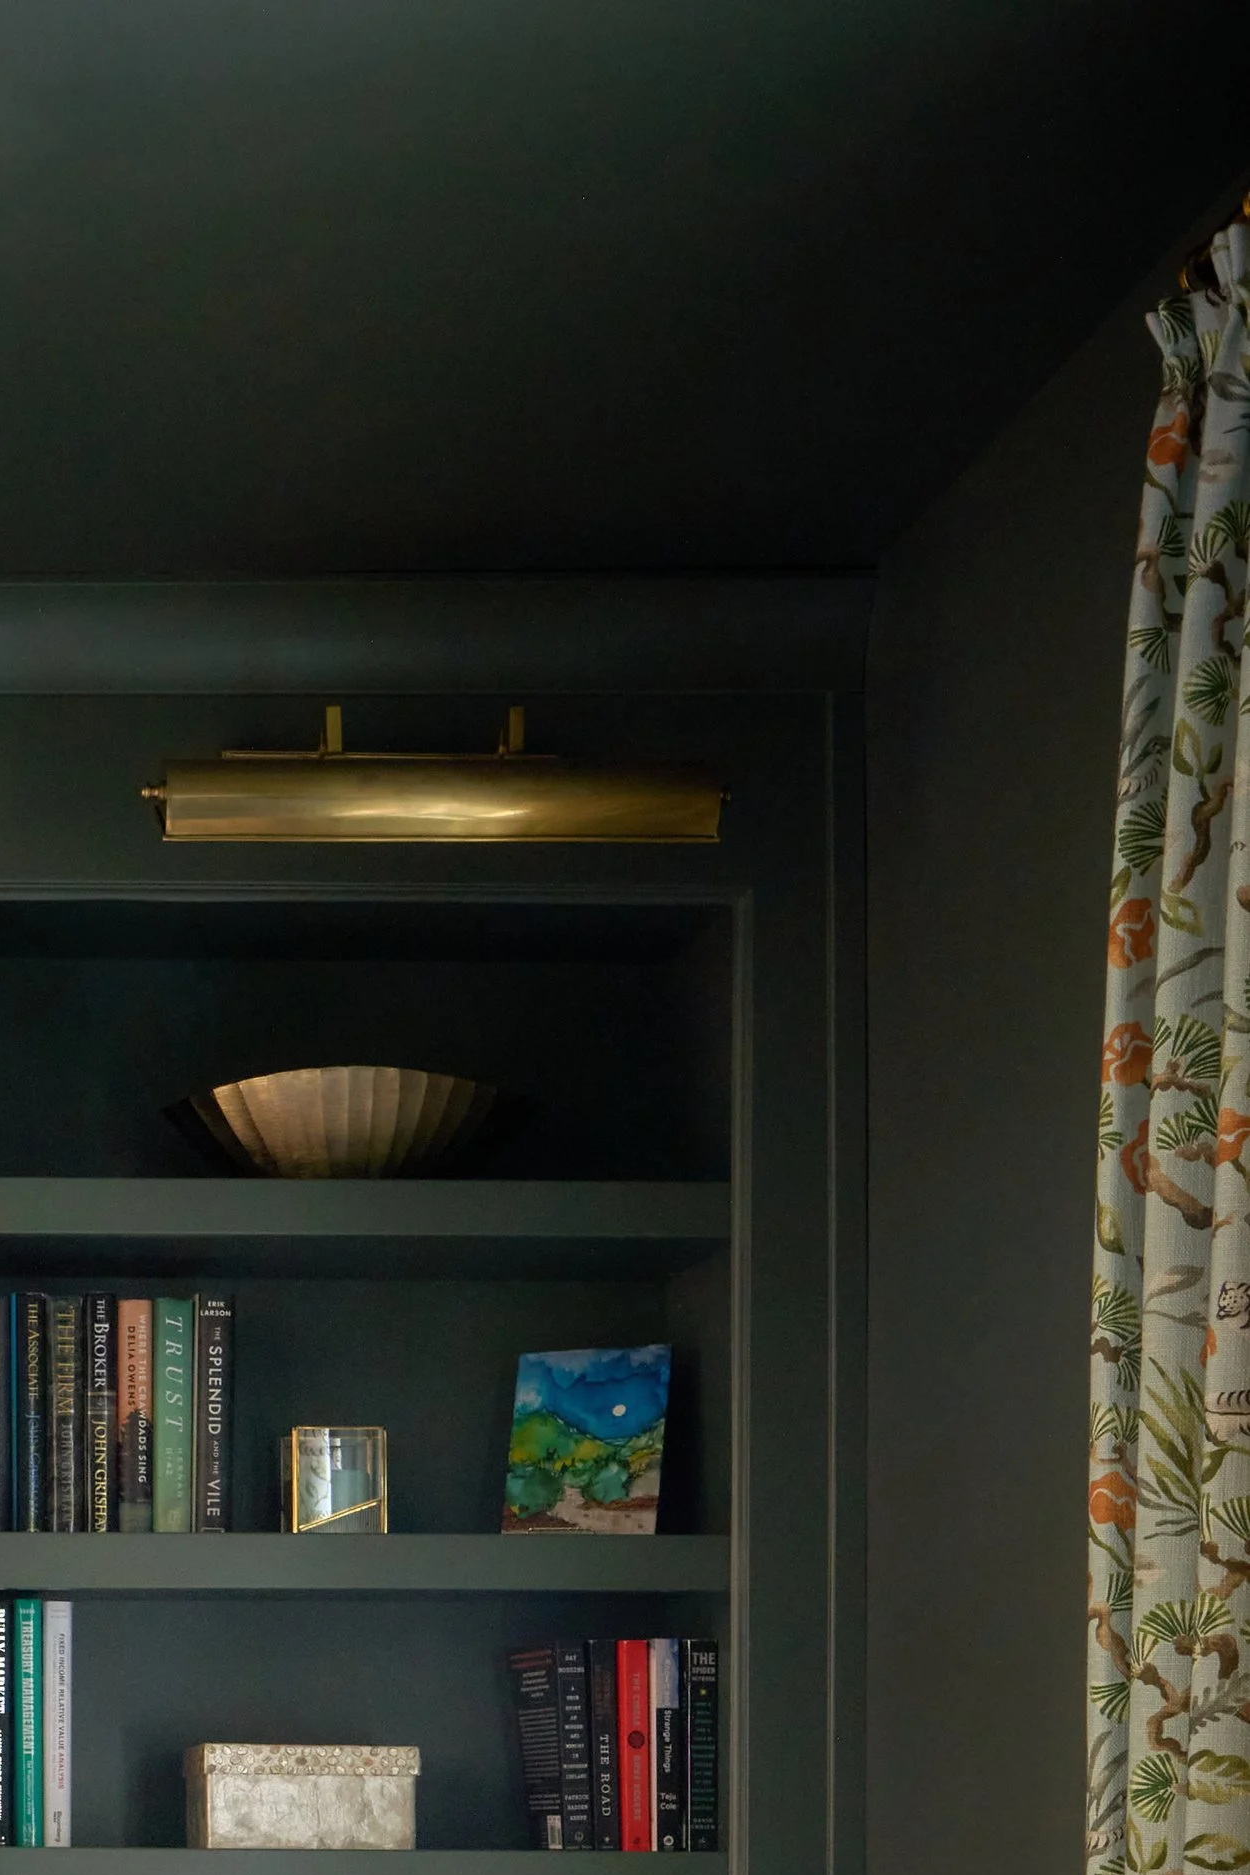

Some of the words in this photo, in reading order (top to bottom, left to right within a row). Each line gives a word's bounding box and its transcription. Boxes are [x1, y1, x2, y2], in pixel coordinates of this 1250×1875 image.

[28, 1302, 39, 1325] THE
[96, 1299, 105, 1320] THE
[200, 1309, 231, 1317] LARSON
[57, 1310, 74, 1354] THE
[127, 1326, 136, 1359] DELIA
[138, 1314, 147, 1354] WHERE
[213, 1327, 221, 1340] THE
[28, 1329, 39, 1399] ASSOCIATE
[138, 1359, 147, 1381] THE
[165, 1316, 184, 1433] TRUST
[57, 1362, 74, 1416] FIRM
[127, 1364, 136, 1406] OWENS
[208, 1346, 223, 1435] SPLENDID
[138, 1386, 147, 1451] CRAWDADS
[61, 1424, 72, 1459] JOHN
[92, 1420, 107, 1464] JOHN
[138, 1455, 147, 1483] SING
[61, 1461, 72, 1522] GRISHAM
[207, 1479, 220, 1517] VILE
[22, 1620, 34, 1674] TREASURY
[692, 1652, 716, 1665] THE
[22, 1677, 34, 1756] MANAGEMENT
[663, 1709, 672, 1742] Strange
[600, 1734, 609, 1765] THE
[663, 1744, 672, 1773] Things
[601, 1773, 612, 1817] ROAD
[660, 1802, 677, 1810] Cole
